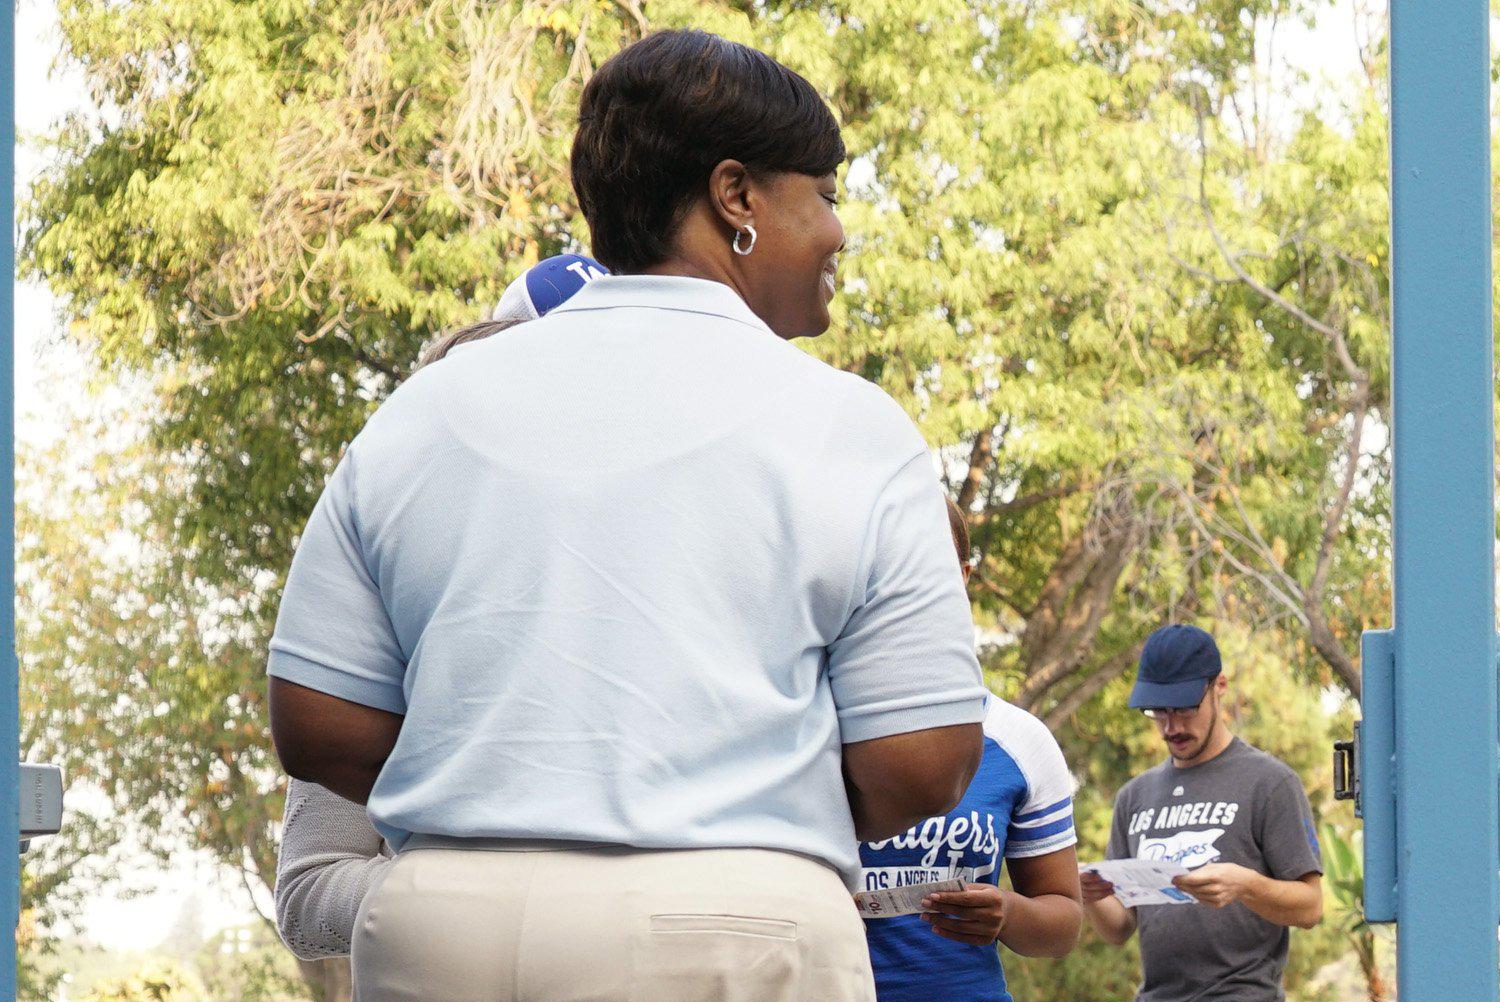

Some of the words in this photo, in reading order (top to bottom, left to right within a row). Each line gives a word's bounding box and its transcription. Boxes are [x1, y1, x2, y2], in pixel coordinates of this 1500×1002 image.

[1128, 808, 1155, 835] LOS
[1154, 801, 1239, 830] ANGELES
[865, 871, 889, 891] OS
